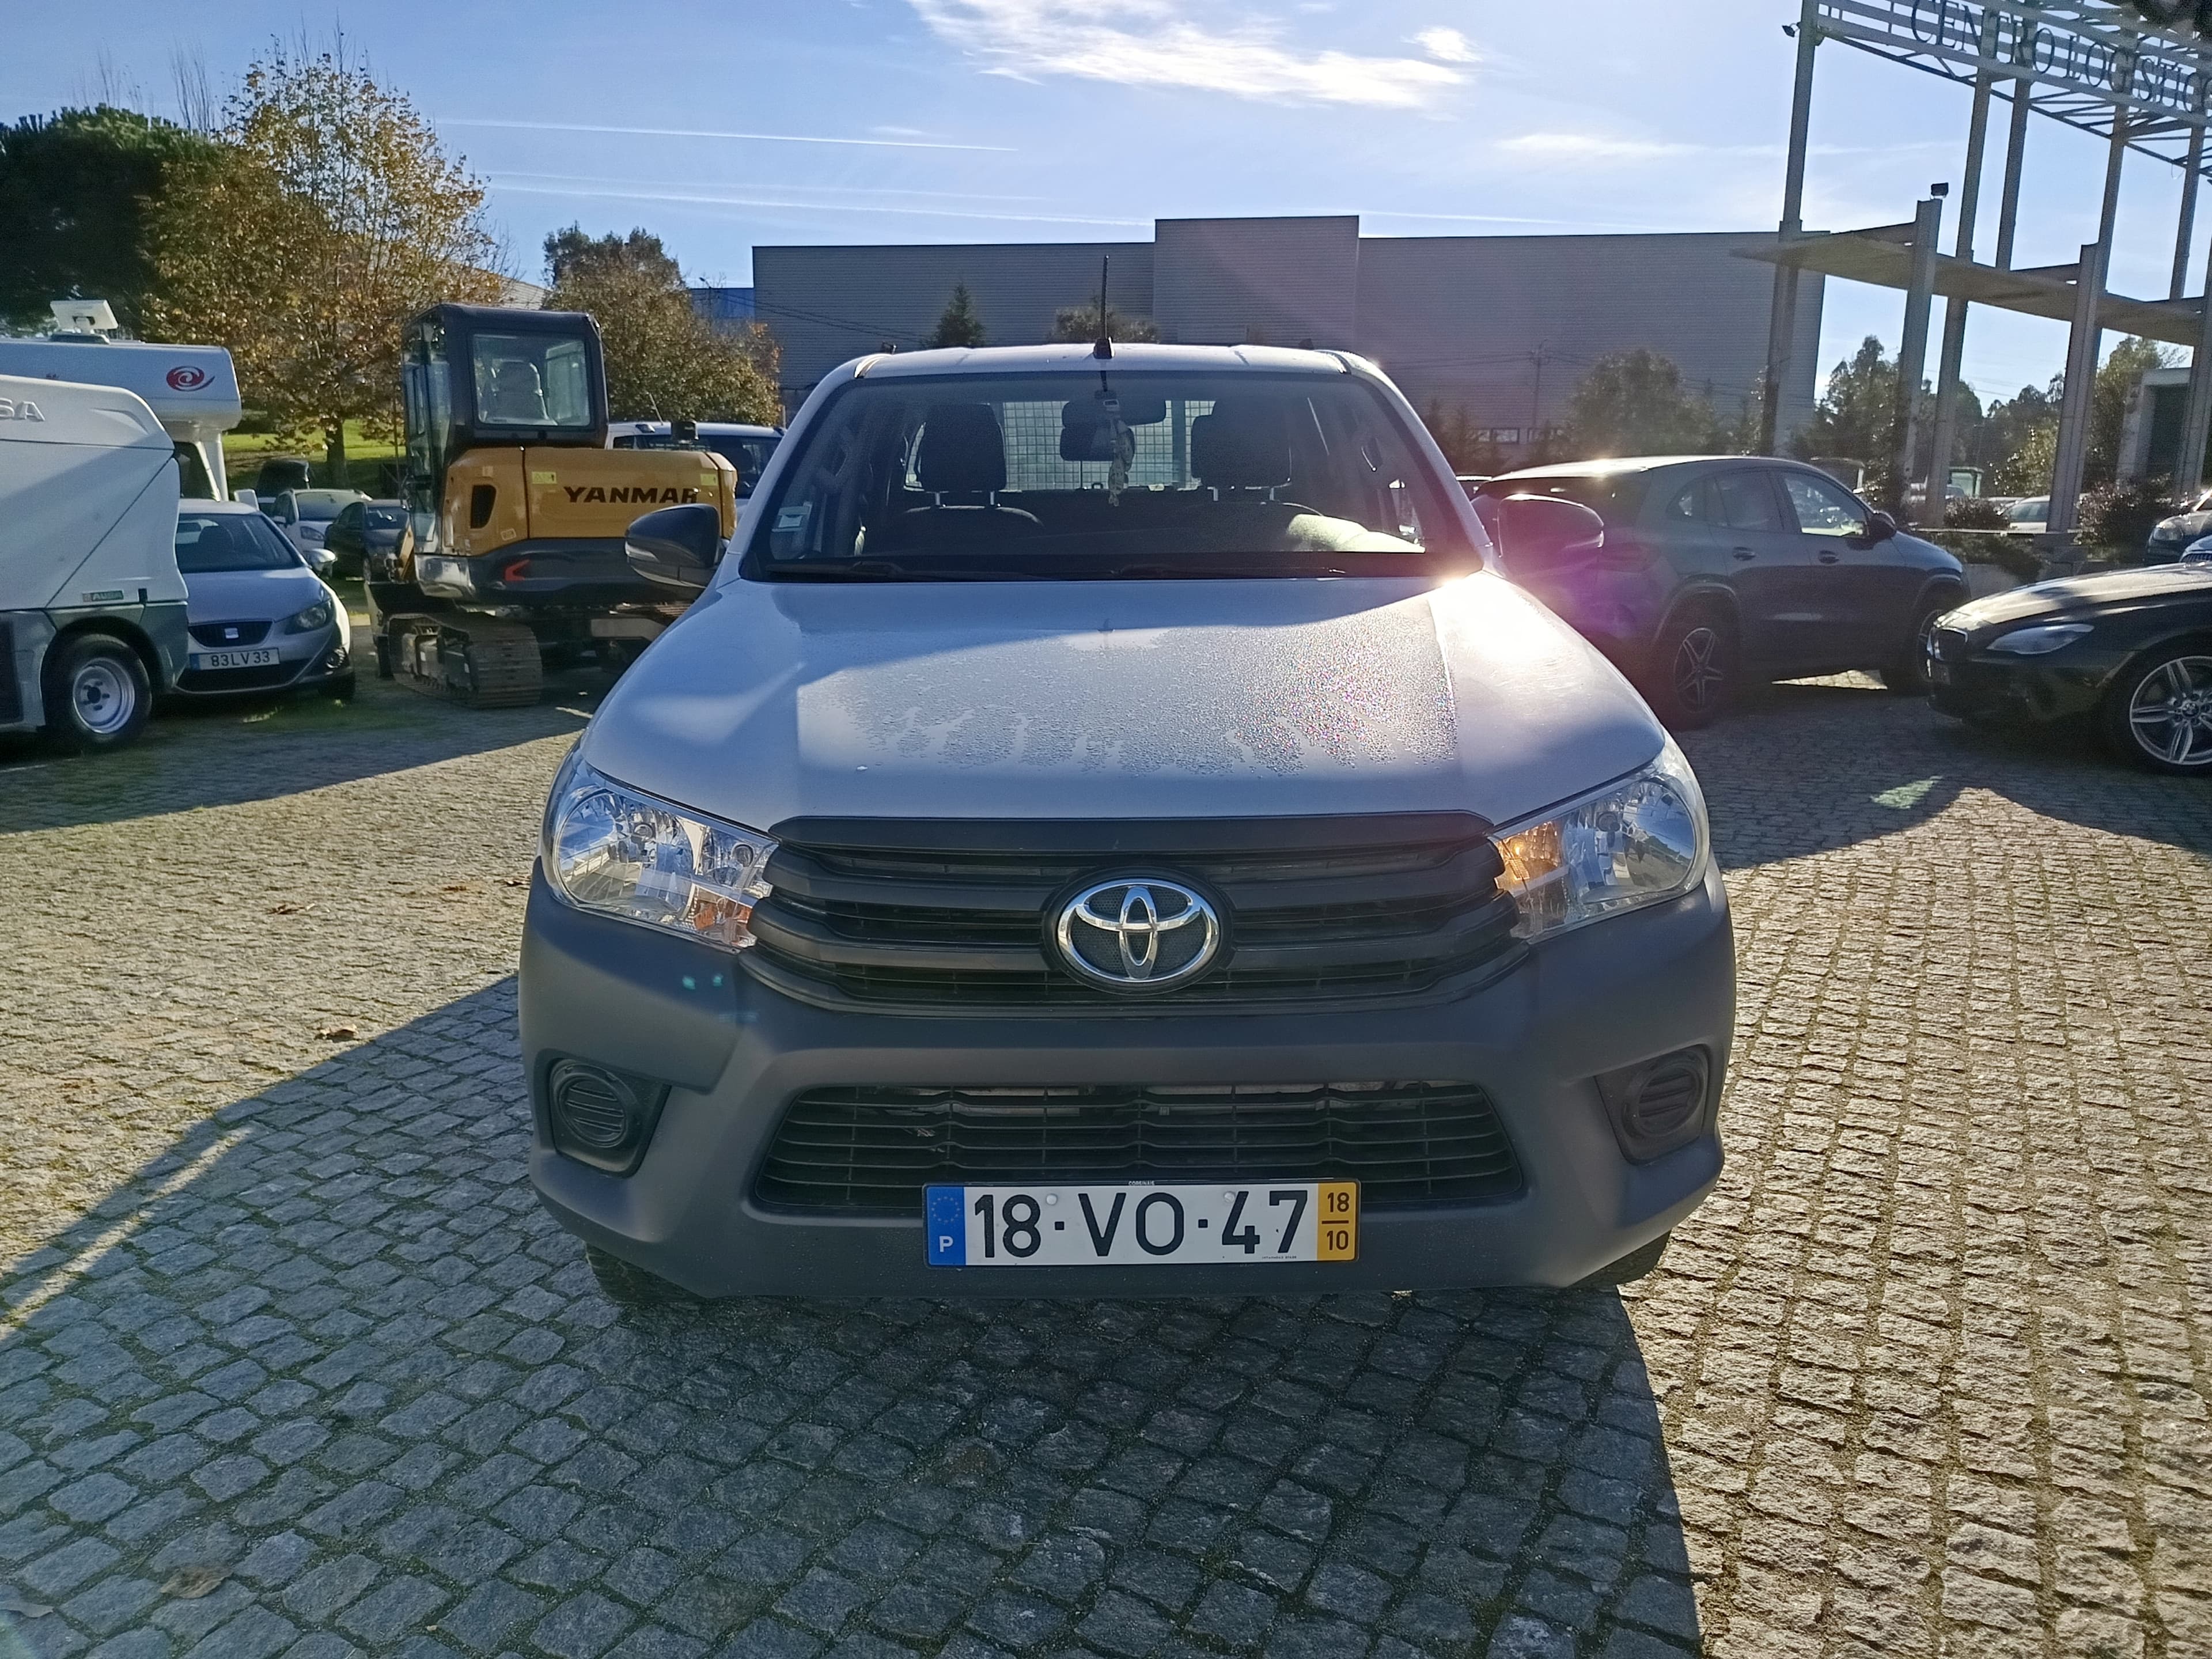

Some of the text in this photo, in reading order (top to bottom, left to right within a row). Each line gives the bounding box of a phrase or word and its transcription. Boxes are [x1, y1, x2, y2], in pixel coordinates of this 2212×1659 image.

[1911, 0, 2055, 74] CENTRO
[564, 487, 698, 503] YANMAR
[1327, 1192, 1350, 1213] 18
[939, 1236, 953, 1252] P
[1327, 1230, 1349, 1251] 10
